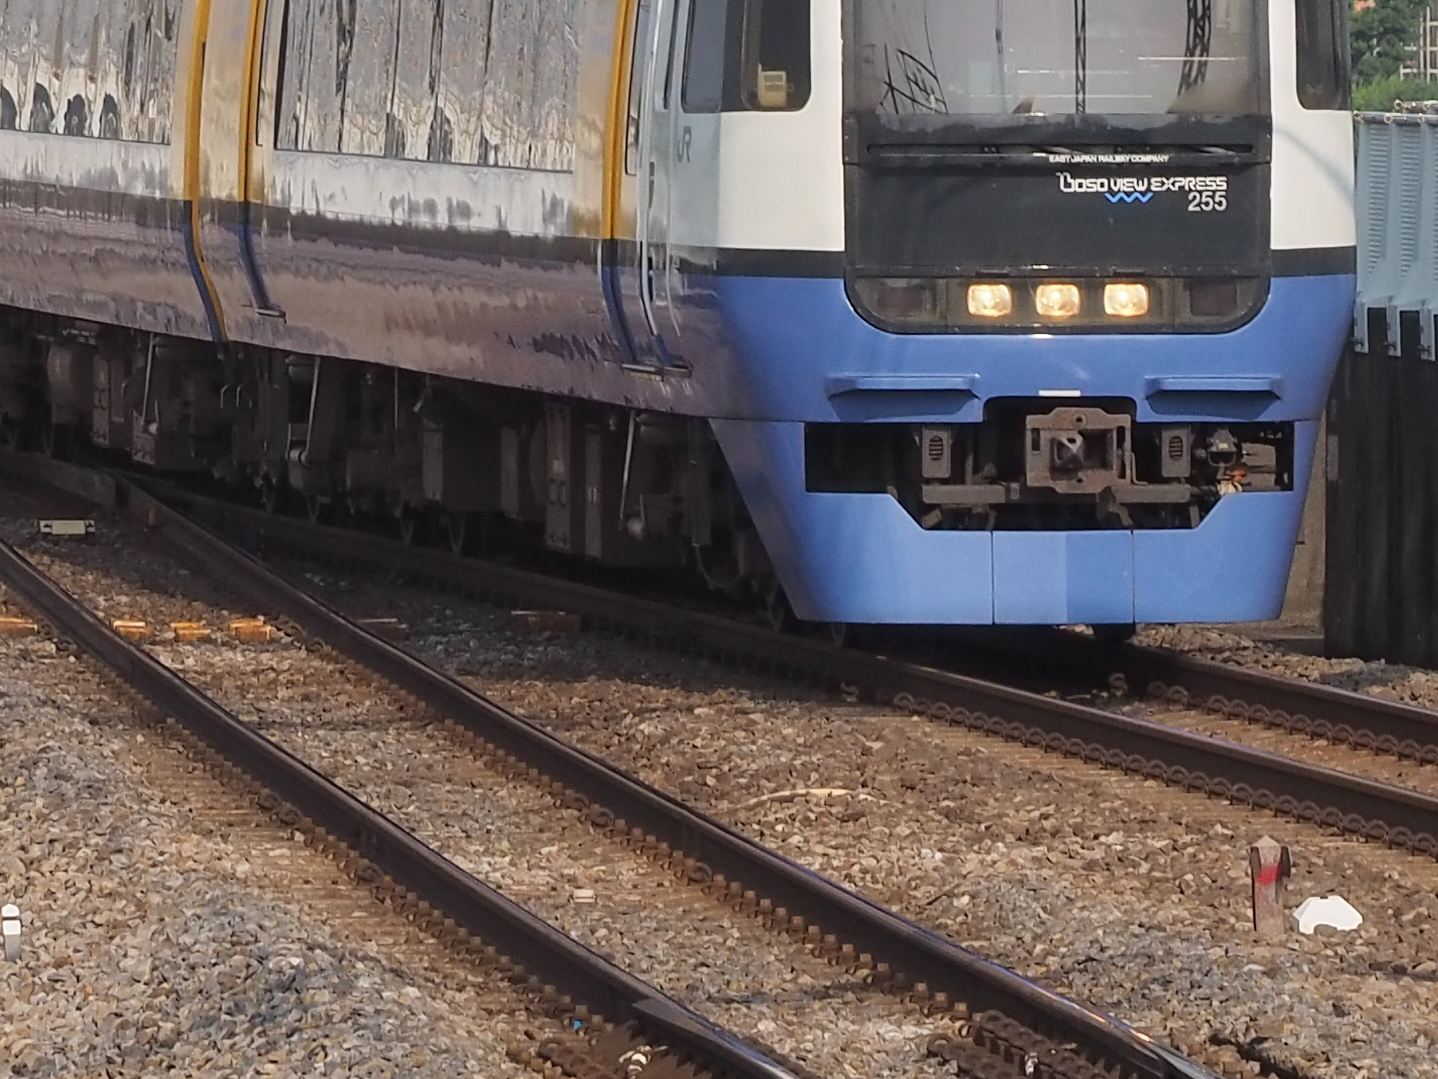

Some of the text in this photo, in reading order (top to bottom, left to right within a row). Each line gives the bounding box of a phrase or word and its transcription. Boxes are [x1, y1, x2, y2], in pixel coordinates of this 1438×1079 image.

[677, 125, 692, 163] JR
[1048, 154, 1070, 163] EAST
[1070, 154, 1097, 163] JAPAN
[1131, 154, 1169, 163] COMPANY
[1110, 177, 1148, 191] VIEW
[1150, 177, 1227, 191] EXPRESS
[1187, 192, 1227, 211] 255
